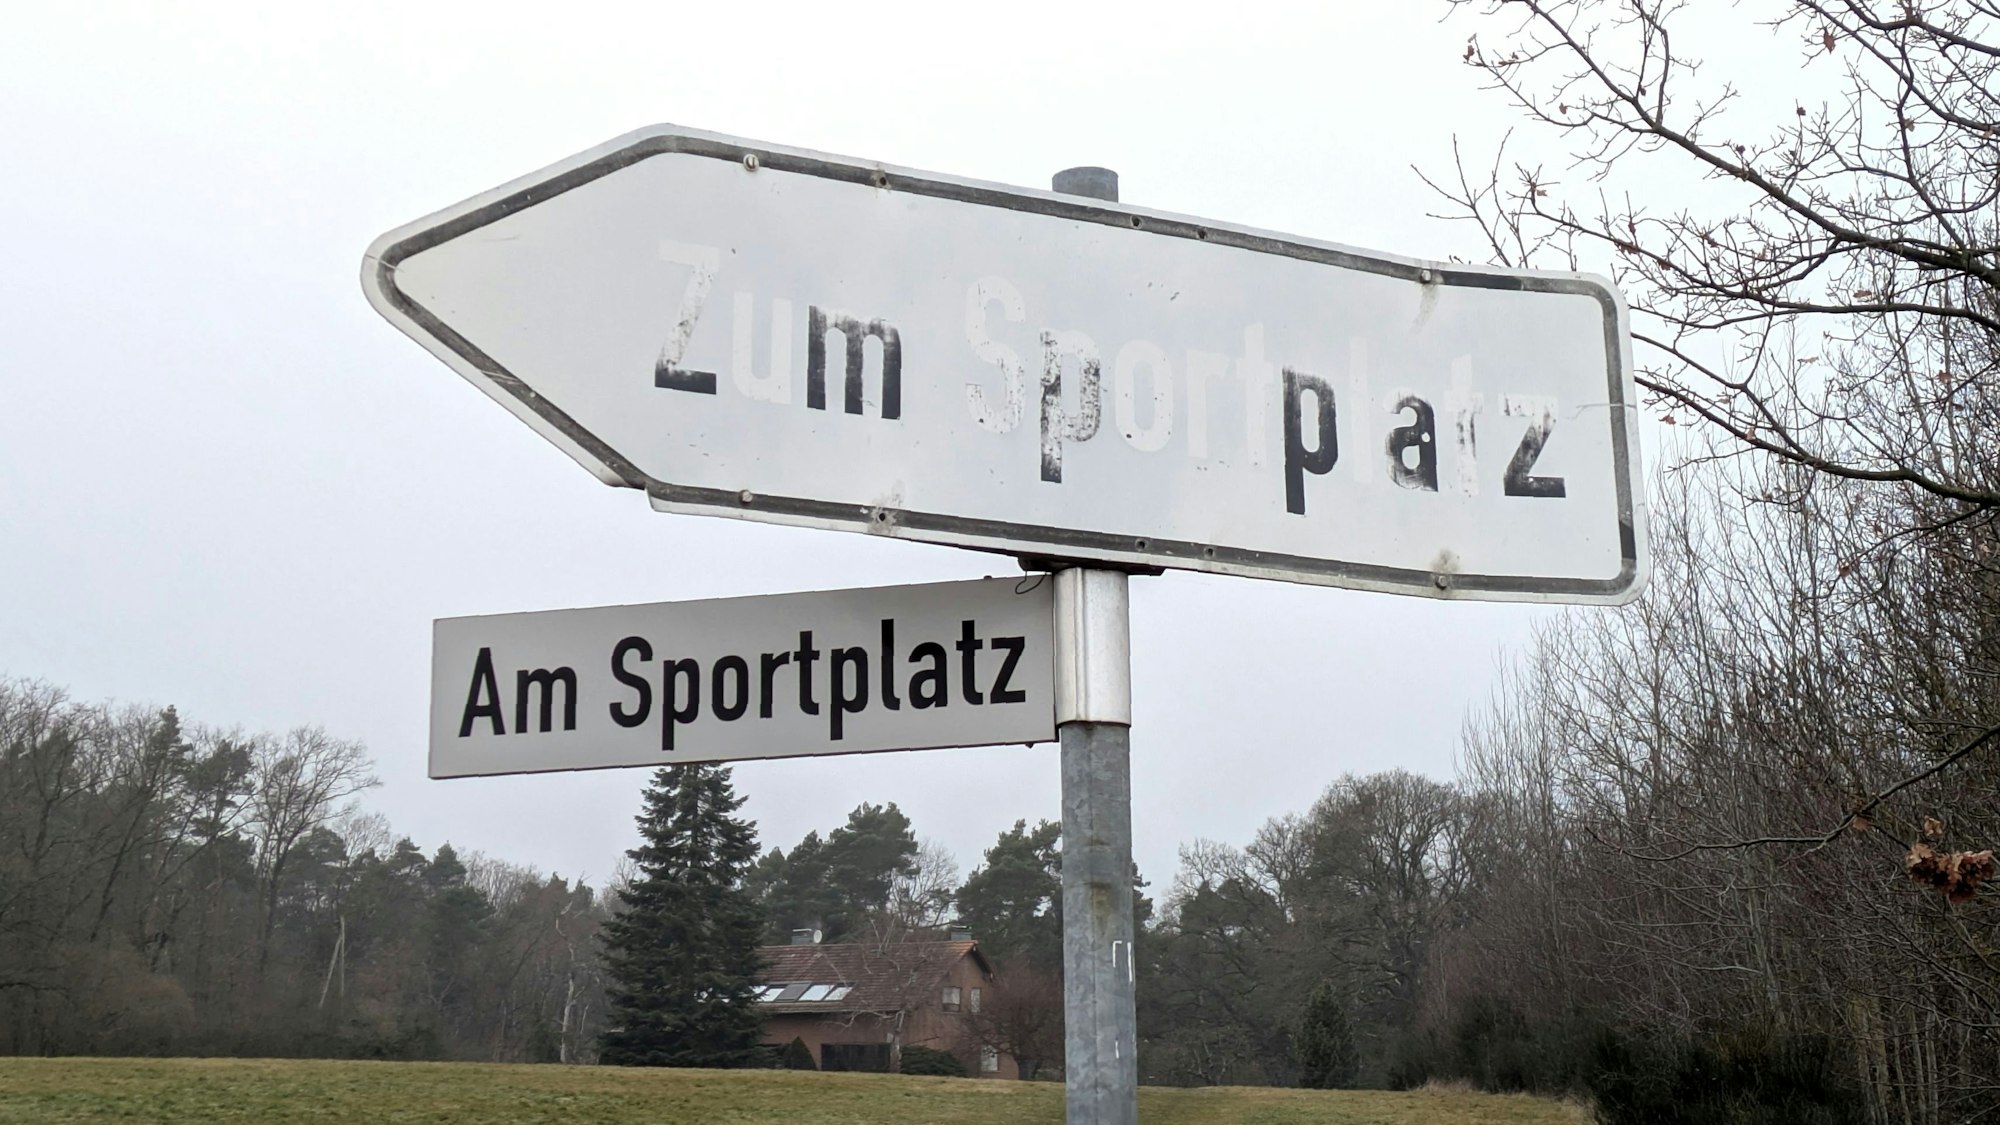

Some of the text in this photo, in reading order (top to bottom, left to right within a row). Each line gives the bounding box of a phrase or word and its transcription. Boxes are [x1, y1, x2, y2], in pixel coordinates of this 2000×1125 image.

[655, 239, 1567, 515] Zum Sportplatz
[458, 618, 1026, 751] Am Sportplatz
